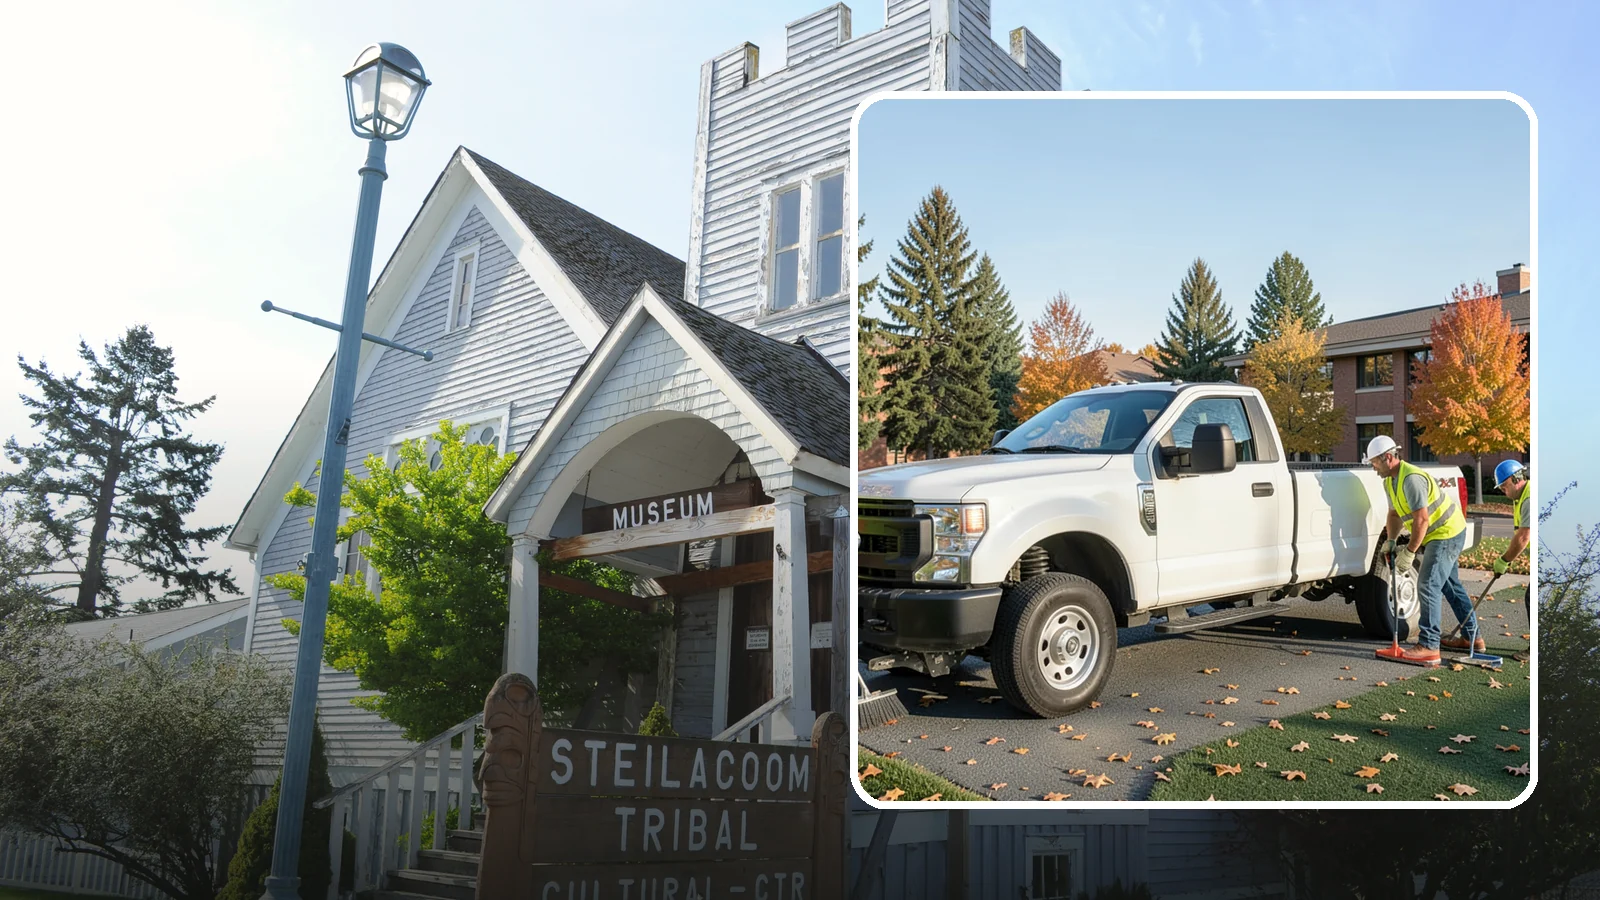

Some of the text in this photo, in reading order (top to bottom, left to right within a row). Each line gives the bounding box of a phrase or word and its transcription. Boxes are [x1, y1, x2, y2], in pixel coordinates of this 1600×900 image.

[613, 491, 713, 531] MUSEUM
[551, 738, 809, 792] STEILACOOM
[615, 806, 758, 852] TRIBAL
